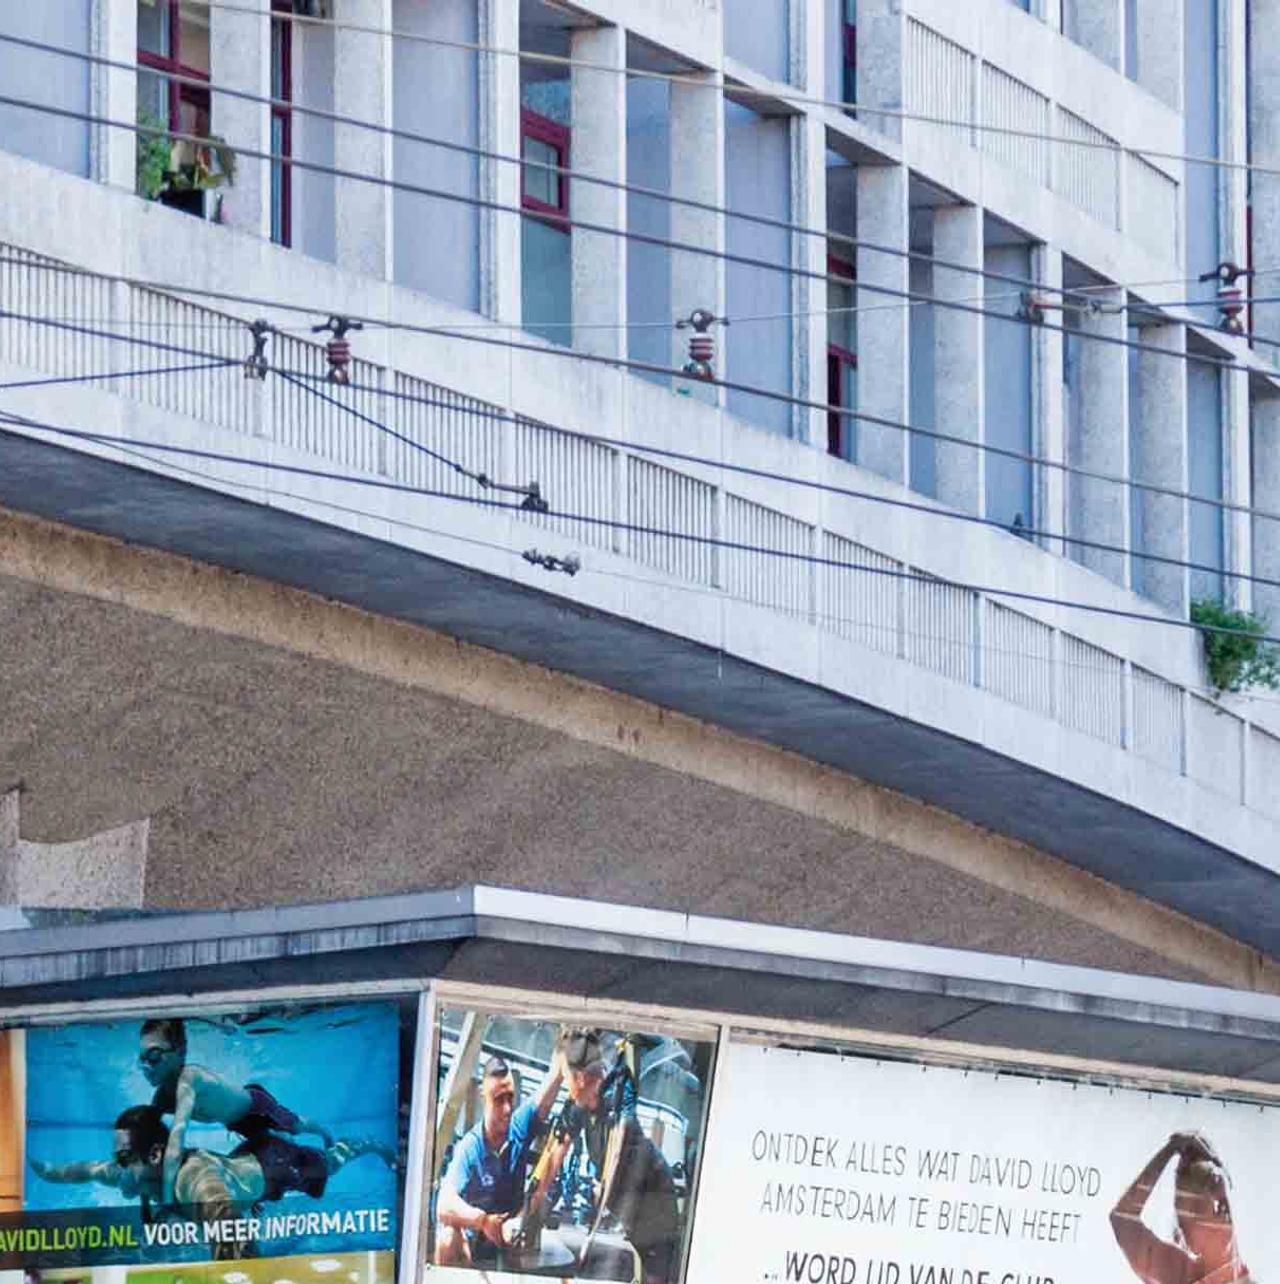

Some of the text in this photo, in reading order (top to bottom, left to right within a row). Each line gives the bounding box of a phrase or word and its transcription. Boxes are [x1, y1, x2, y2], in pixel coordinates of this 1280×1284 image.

[751, 1130, 1102, 1198] ONTDEK ALLES WAT DAVID LLOYD
[143, 1221, 198, 1246] VOOR
[202, 1217, 261, 1244] MEER
[264, 1208, 390, 1240] INFORMATIE
[760, 1182, 1083, 1243] AMSTERDAM TE BIEDEN HEEFT
